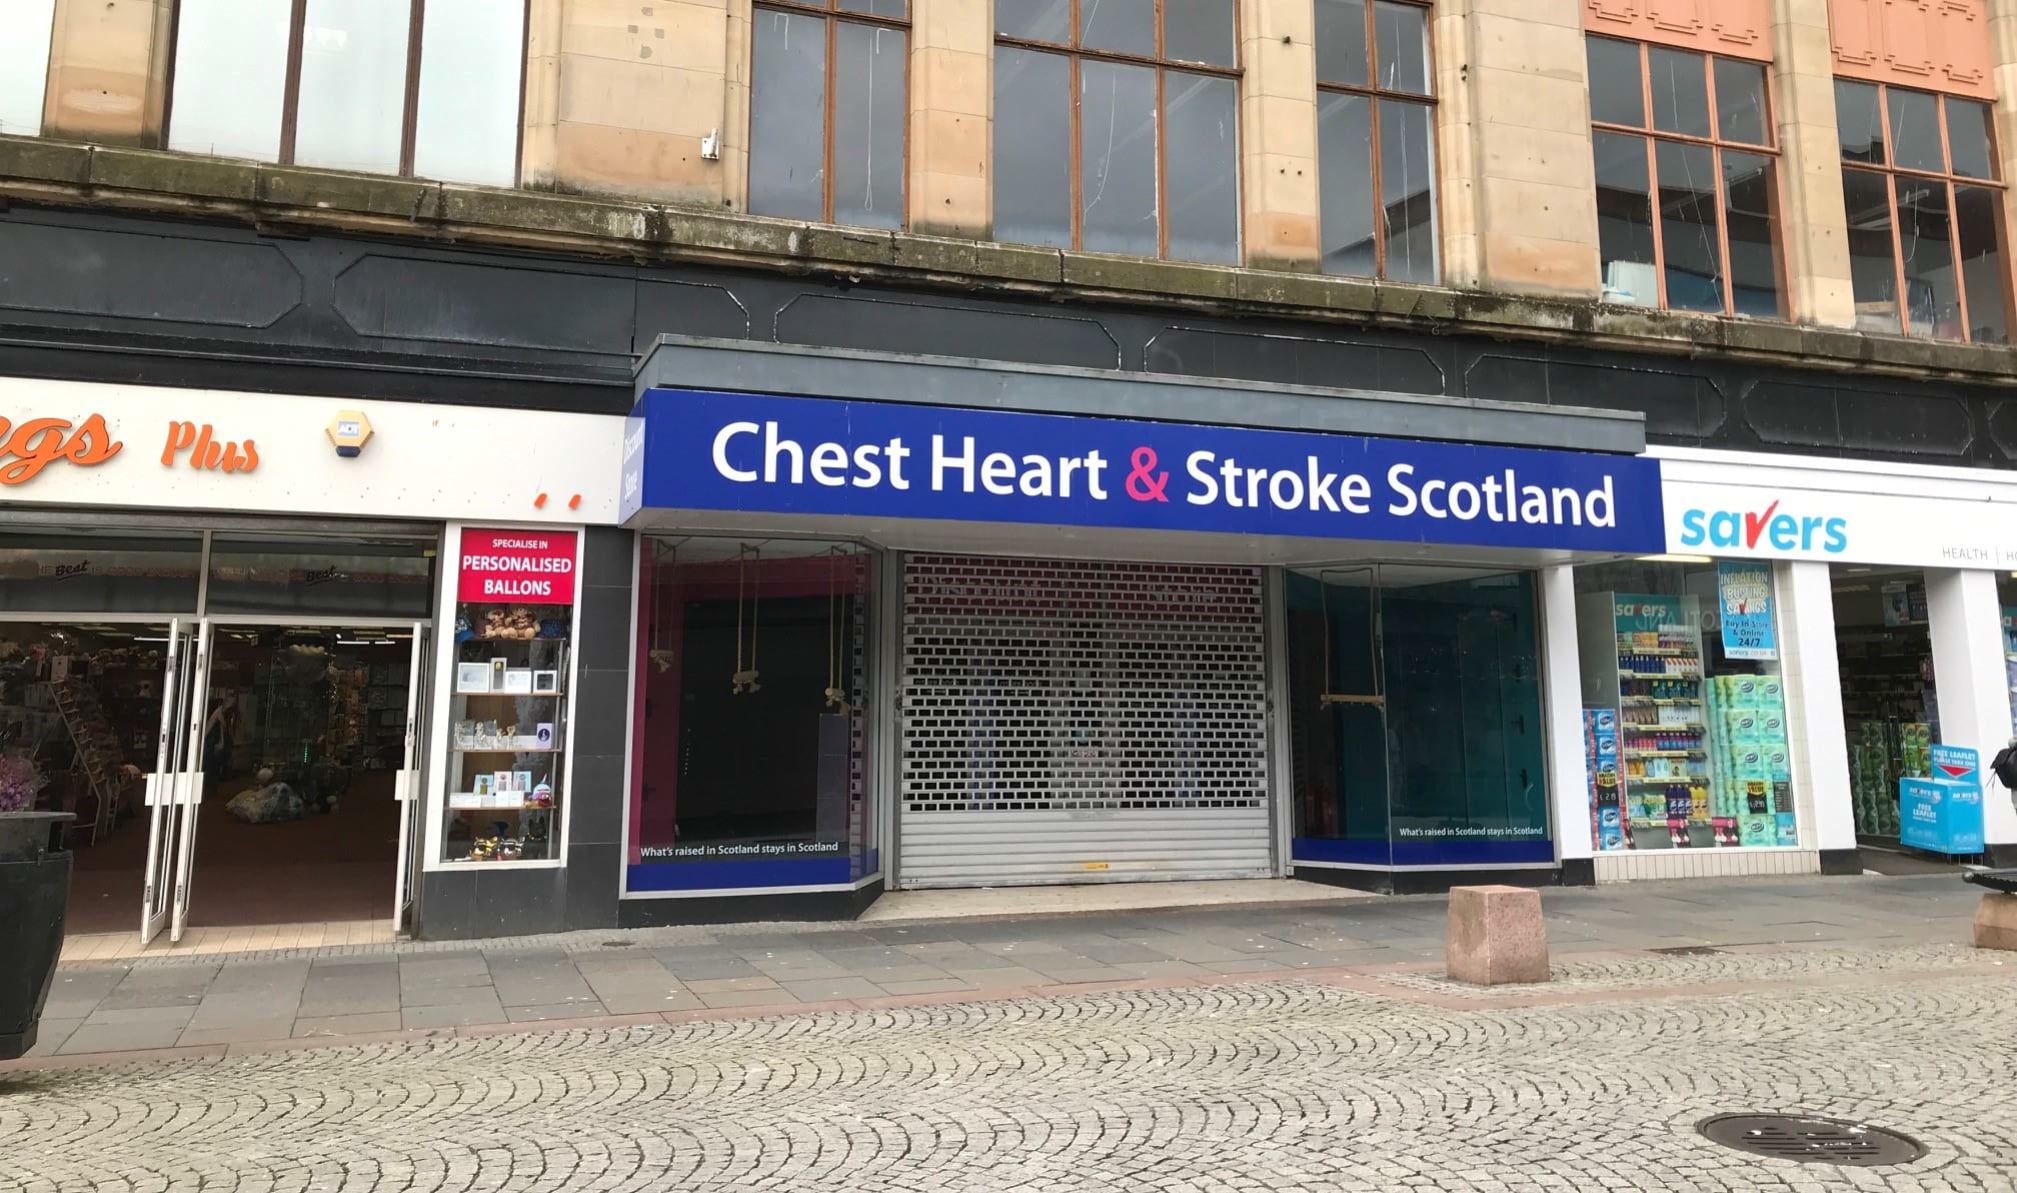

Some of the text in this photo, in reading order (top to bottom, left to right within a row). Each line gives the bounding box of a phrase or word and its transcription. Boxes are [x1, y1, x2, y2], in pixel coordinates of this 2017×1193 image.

[161, 421, 259, 474] Plus
[711, 421, 1617, 528] Chest Heart & Stroke Scotland
[1680, 500, 1848, 554] savers
[492, 539, 548, 549] SPECIALISE IN
[1942, 547, 1989, 560] HEALTH
[462, 555, 572, 573] PERSONALISED
[484, 579, 551, 596] BALLONS
[1615, 602, 1667, 617] savers
[1739, 638, 1760, 647] 24/7
[1400, 826, 1543, 837] What's raised in Scotland stays in Scotland
[640, 841, 839, 857] What's raised in Scotland stays in Scotland
